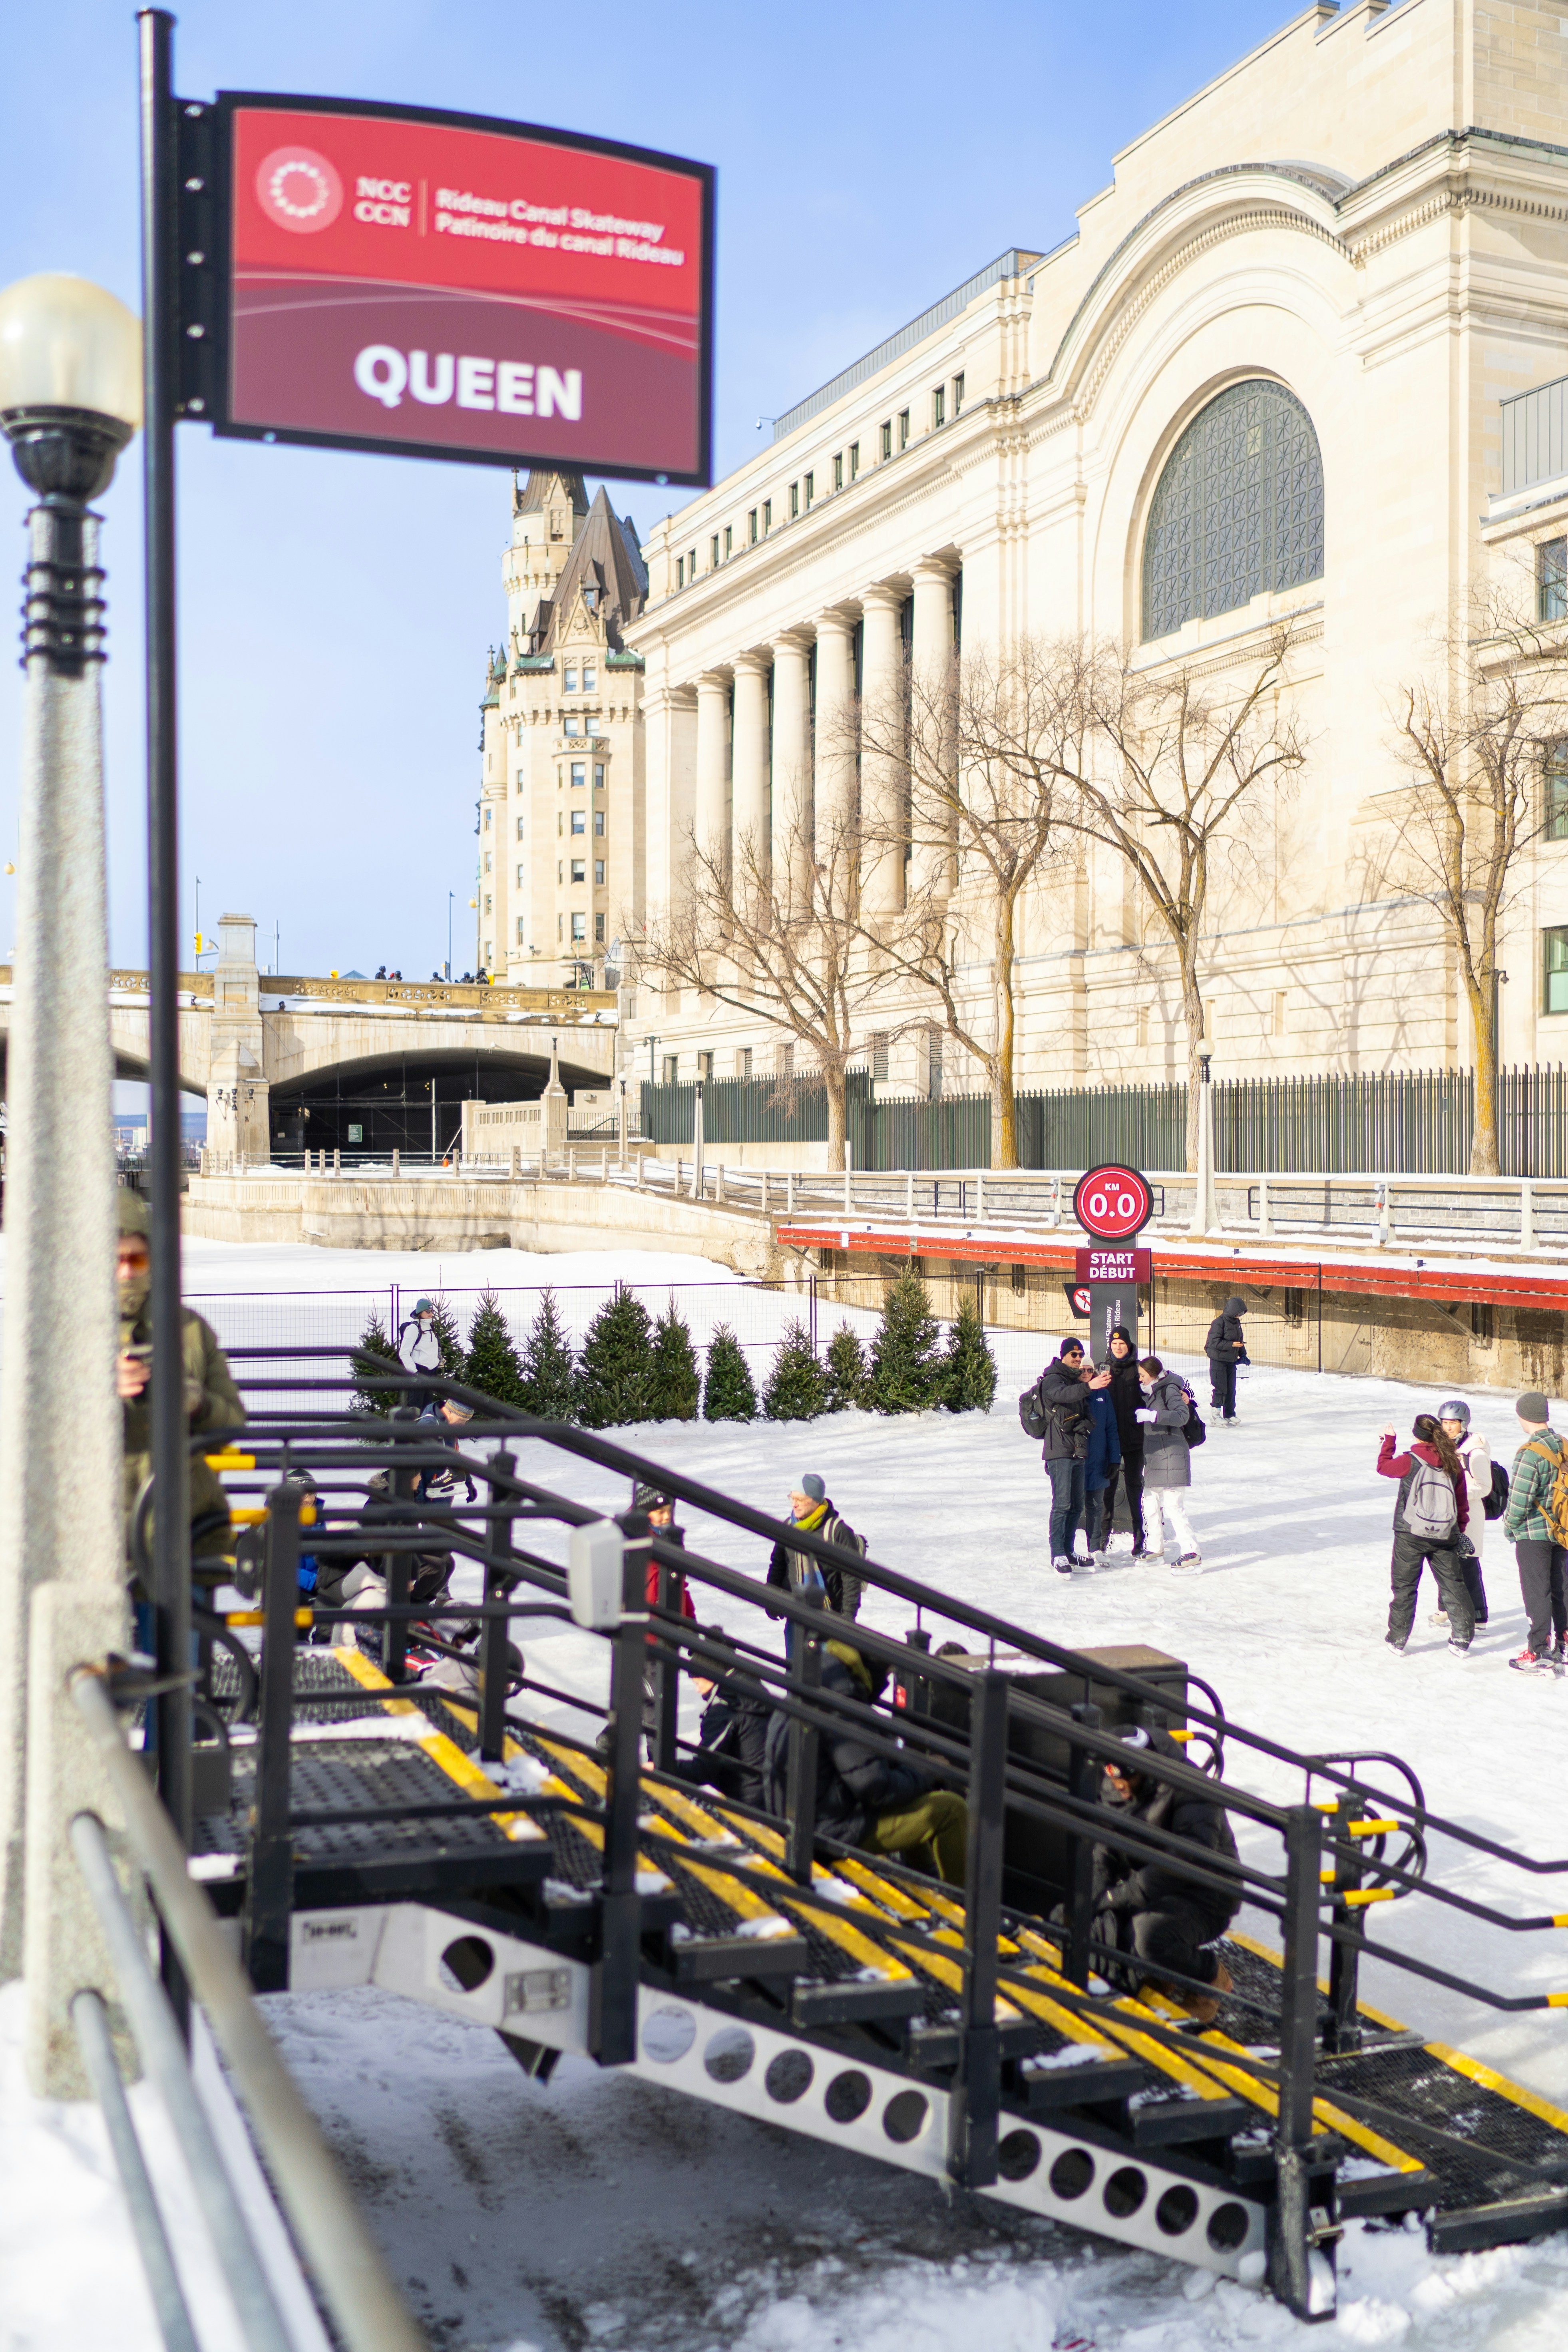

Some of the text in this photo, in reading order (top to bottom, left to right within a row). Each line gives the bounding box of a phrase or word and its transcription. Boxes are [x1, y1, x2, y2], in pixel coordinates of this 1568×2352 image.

[356, 176, 412, 203] NCC
[354, 200, 411, 227] CCN
[435, 188, 665, 243] Rideau Canal Skateway
[434, 211, 685, 266] Patinoire du canal Rideau
[353, 343, 582, 421] QUEEN
[1090, 1193, 1135, 1217] 0.0
[1090, 1265, 1136, 1278] DÉBUT
[1091, 1253, 1134, 1264] START
